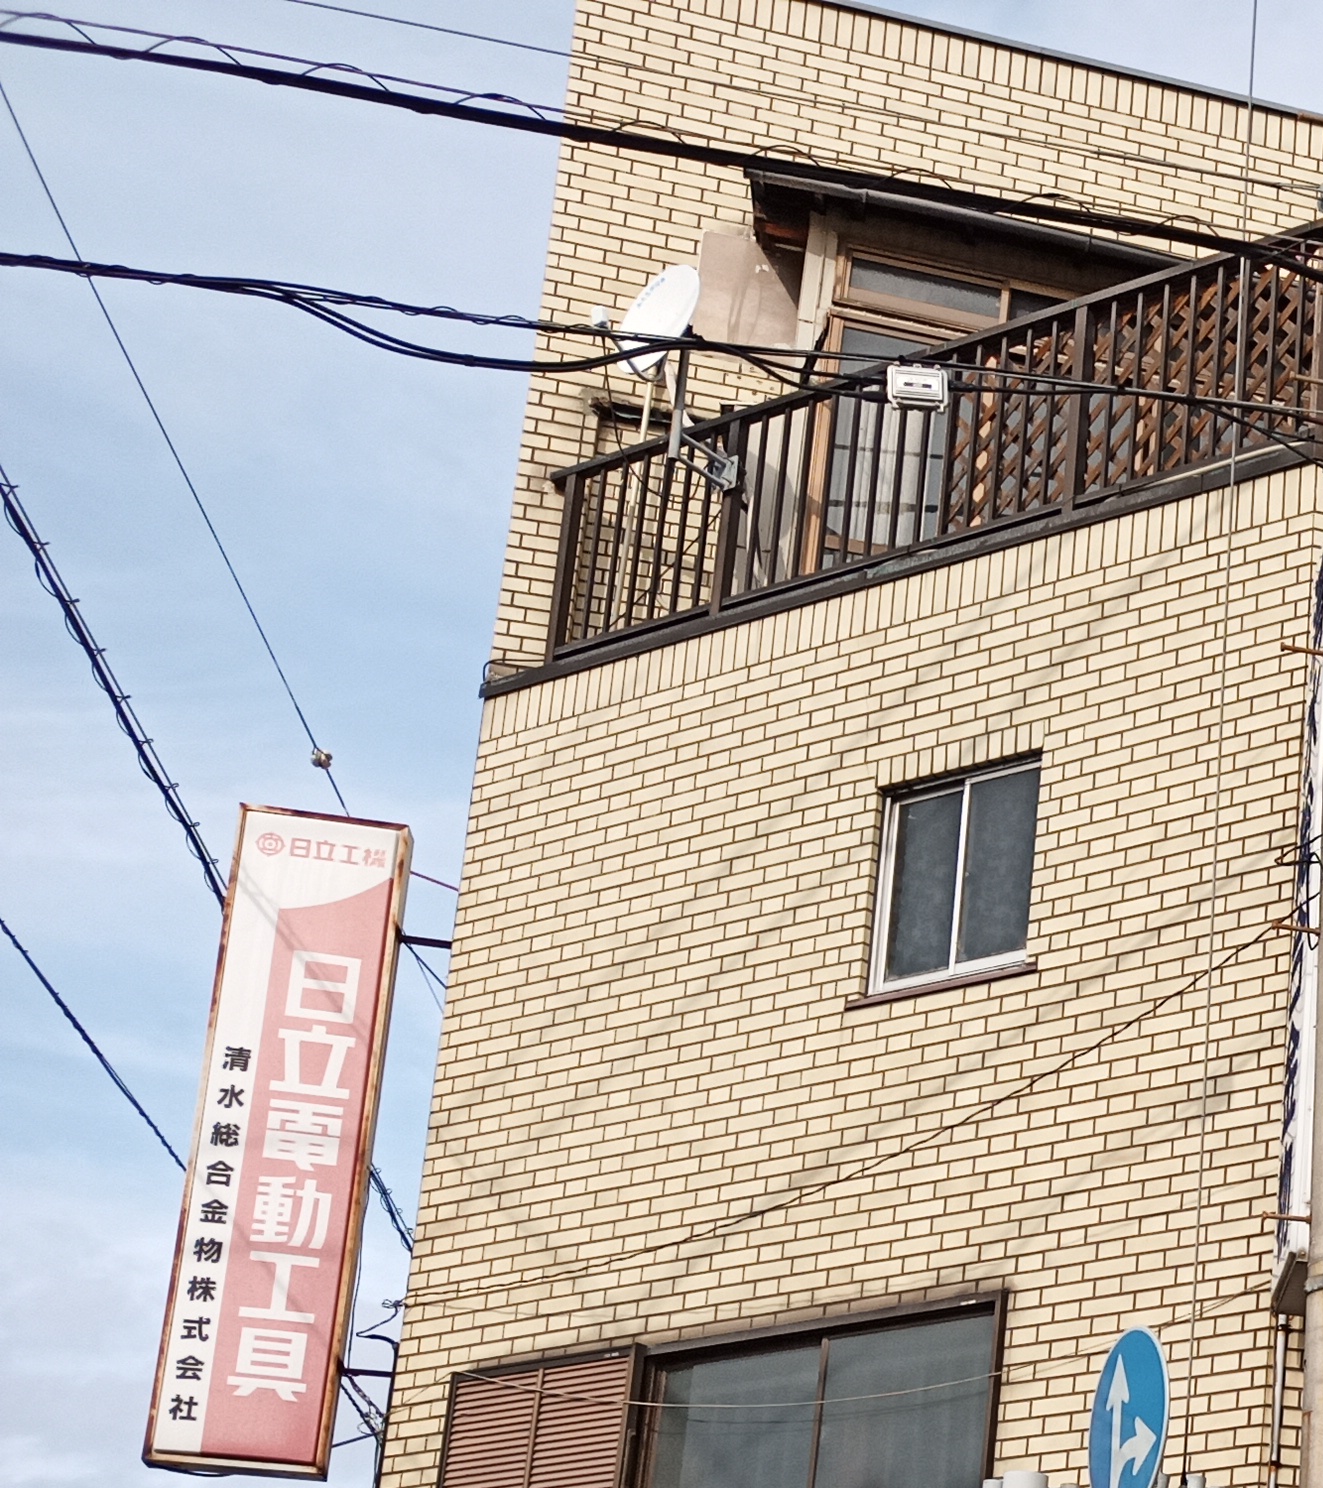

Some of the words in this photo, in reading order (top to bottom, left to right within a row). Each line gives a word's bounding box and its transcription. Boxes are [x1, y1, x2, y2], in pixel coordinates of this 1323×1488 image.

[289, 837, 387, 868] 日立工機
[167, 1044, 252, 1423] 清水総合金物株式会社
[226, 949, 363, 1403] 日立電動工具
